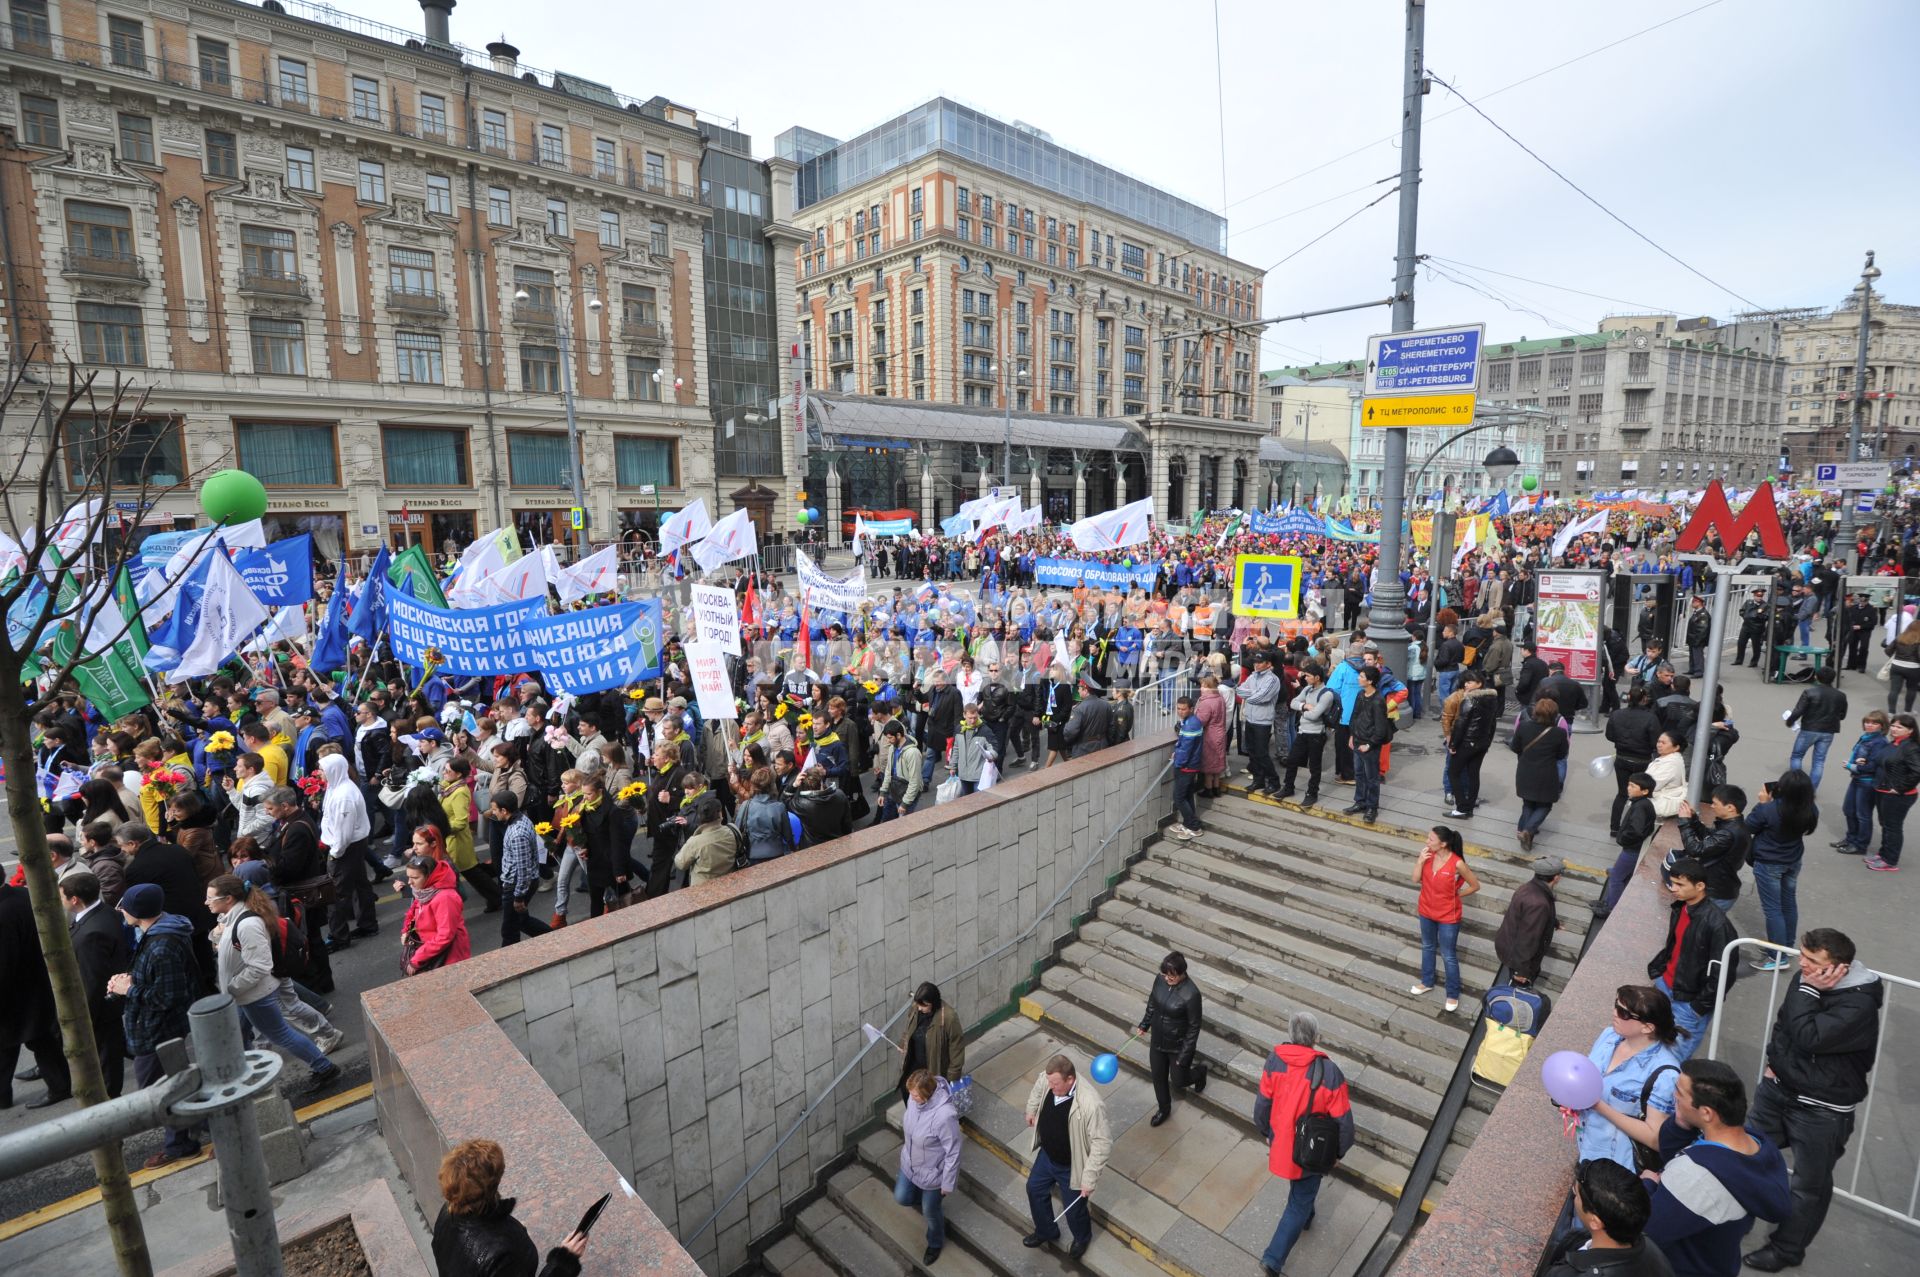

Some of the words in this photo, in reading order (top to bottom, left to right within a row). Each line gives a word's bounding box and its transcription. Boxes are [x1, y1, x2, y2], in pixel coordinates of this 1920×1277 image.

[1401, 334, 1465, 348] ШЕРЕМЕТЬЕВО
[1400, 346, 1466, 360] SHEREMETYEVO
[1379, 367, 1397, 376] E105
[1400, 361, 1475, 374] САНКТ-ПЕТЕРБУРГ
[1378, 378, 1393, 387] M10
[1397, 374, 1467, 386] ST.-PETERSBURG
[1380, 408, 1389, 416] ТЦ
[1391, 406, 1447, 416] МЕТРОПОЛИС
[1452, 405, 1469, 414] 10.5
[267, 501, 302, 509] TEFANO
[1037, 565, 1082, 578] ПРОФСОЮЗ
[1085, 569, 1140, 583] ОБРАЗОВАНИЯ
[696, 591, 732, 608] МОСКВА-
[393, 598, 489, 634] МОСКОВСКАЯ
[531, 613, 623, 647] НИЗАЦИЯ
[699, 609, 734, 627] УЮТНЫЙ
[704, 626, 732, 646] ГОРОД!
[696, 657, 717, 668] МИР!
[697, 670, 722, 681] ТРУД!
[701, 681, 723, 693] МАЙ!
